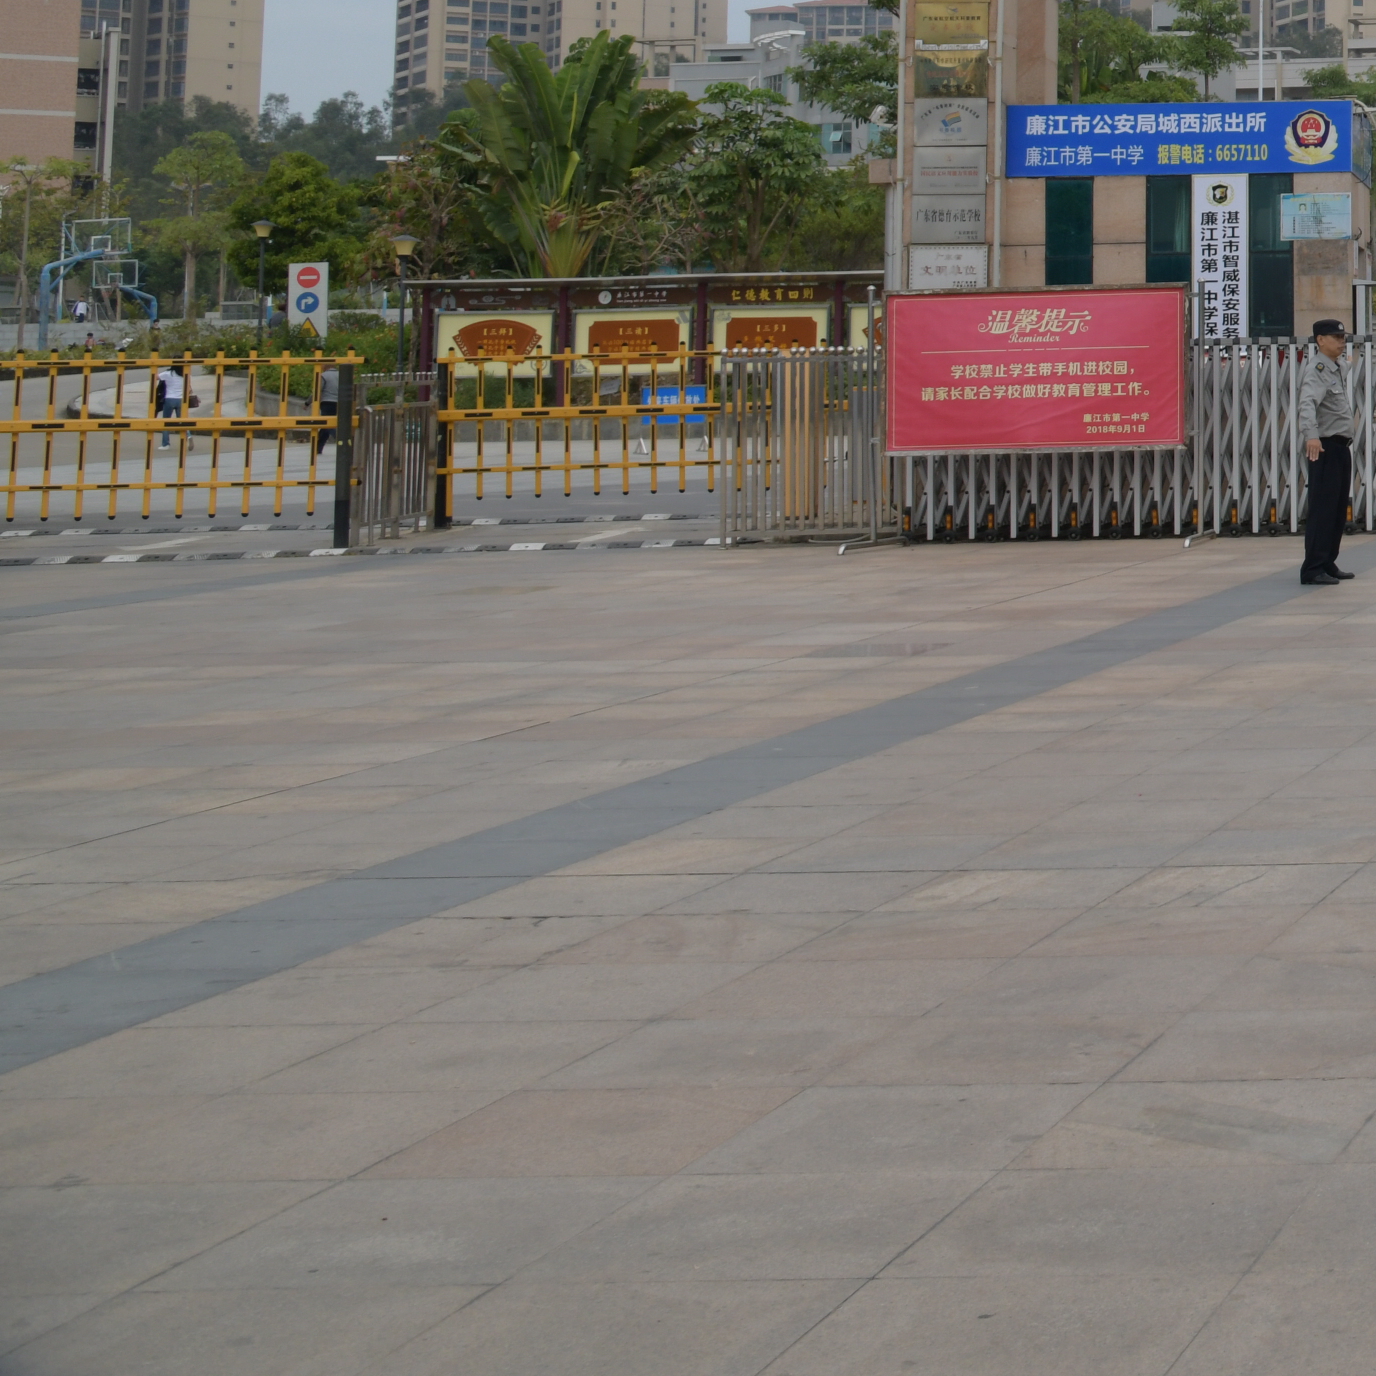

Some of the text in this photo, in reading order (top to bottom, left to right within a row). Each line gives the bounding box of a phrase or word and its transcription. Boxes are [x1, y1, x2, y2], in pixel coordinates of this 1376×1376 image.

[1025, 112, 1267, 136] 廉江市公安局城西派出所
[1025, 143, 1269, 167] 廉江市第一中学 报警电话：6657110
[916, 209, 981, 222] 广东省德育示范学校
[1221, 210, 1241, 338] 湛江市智威保安服务
[977, 308, 1092, 335] 温馨提示
[1008, 333, 1061, 344] Reminder
[950, 360, 1135, 379] 学校禁止学生带手机进校园，
[921, 382, 1150, 402] 请家长配合学校做好教育管理工作。
[1083, 412, 1150, 423] 廉江市第一中学
[1086, 424, 1146, 434] 2018年9月1日
